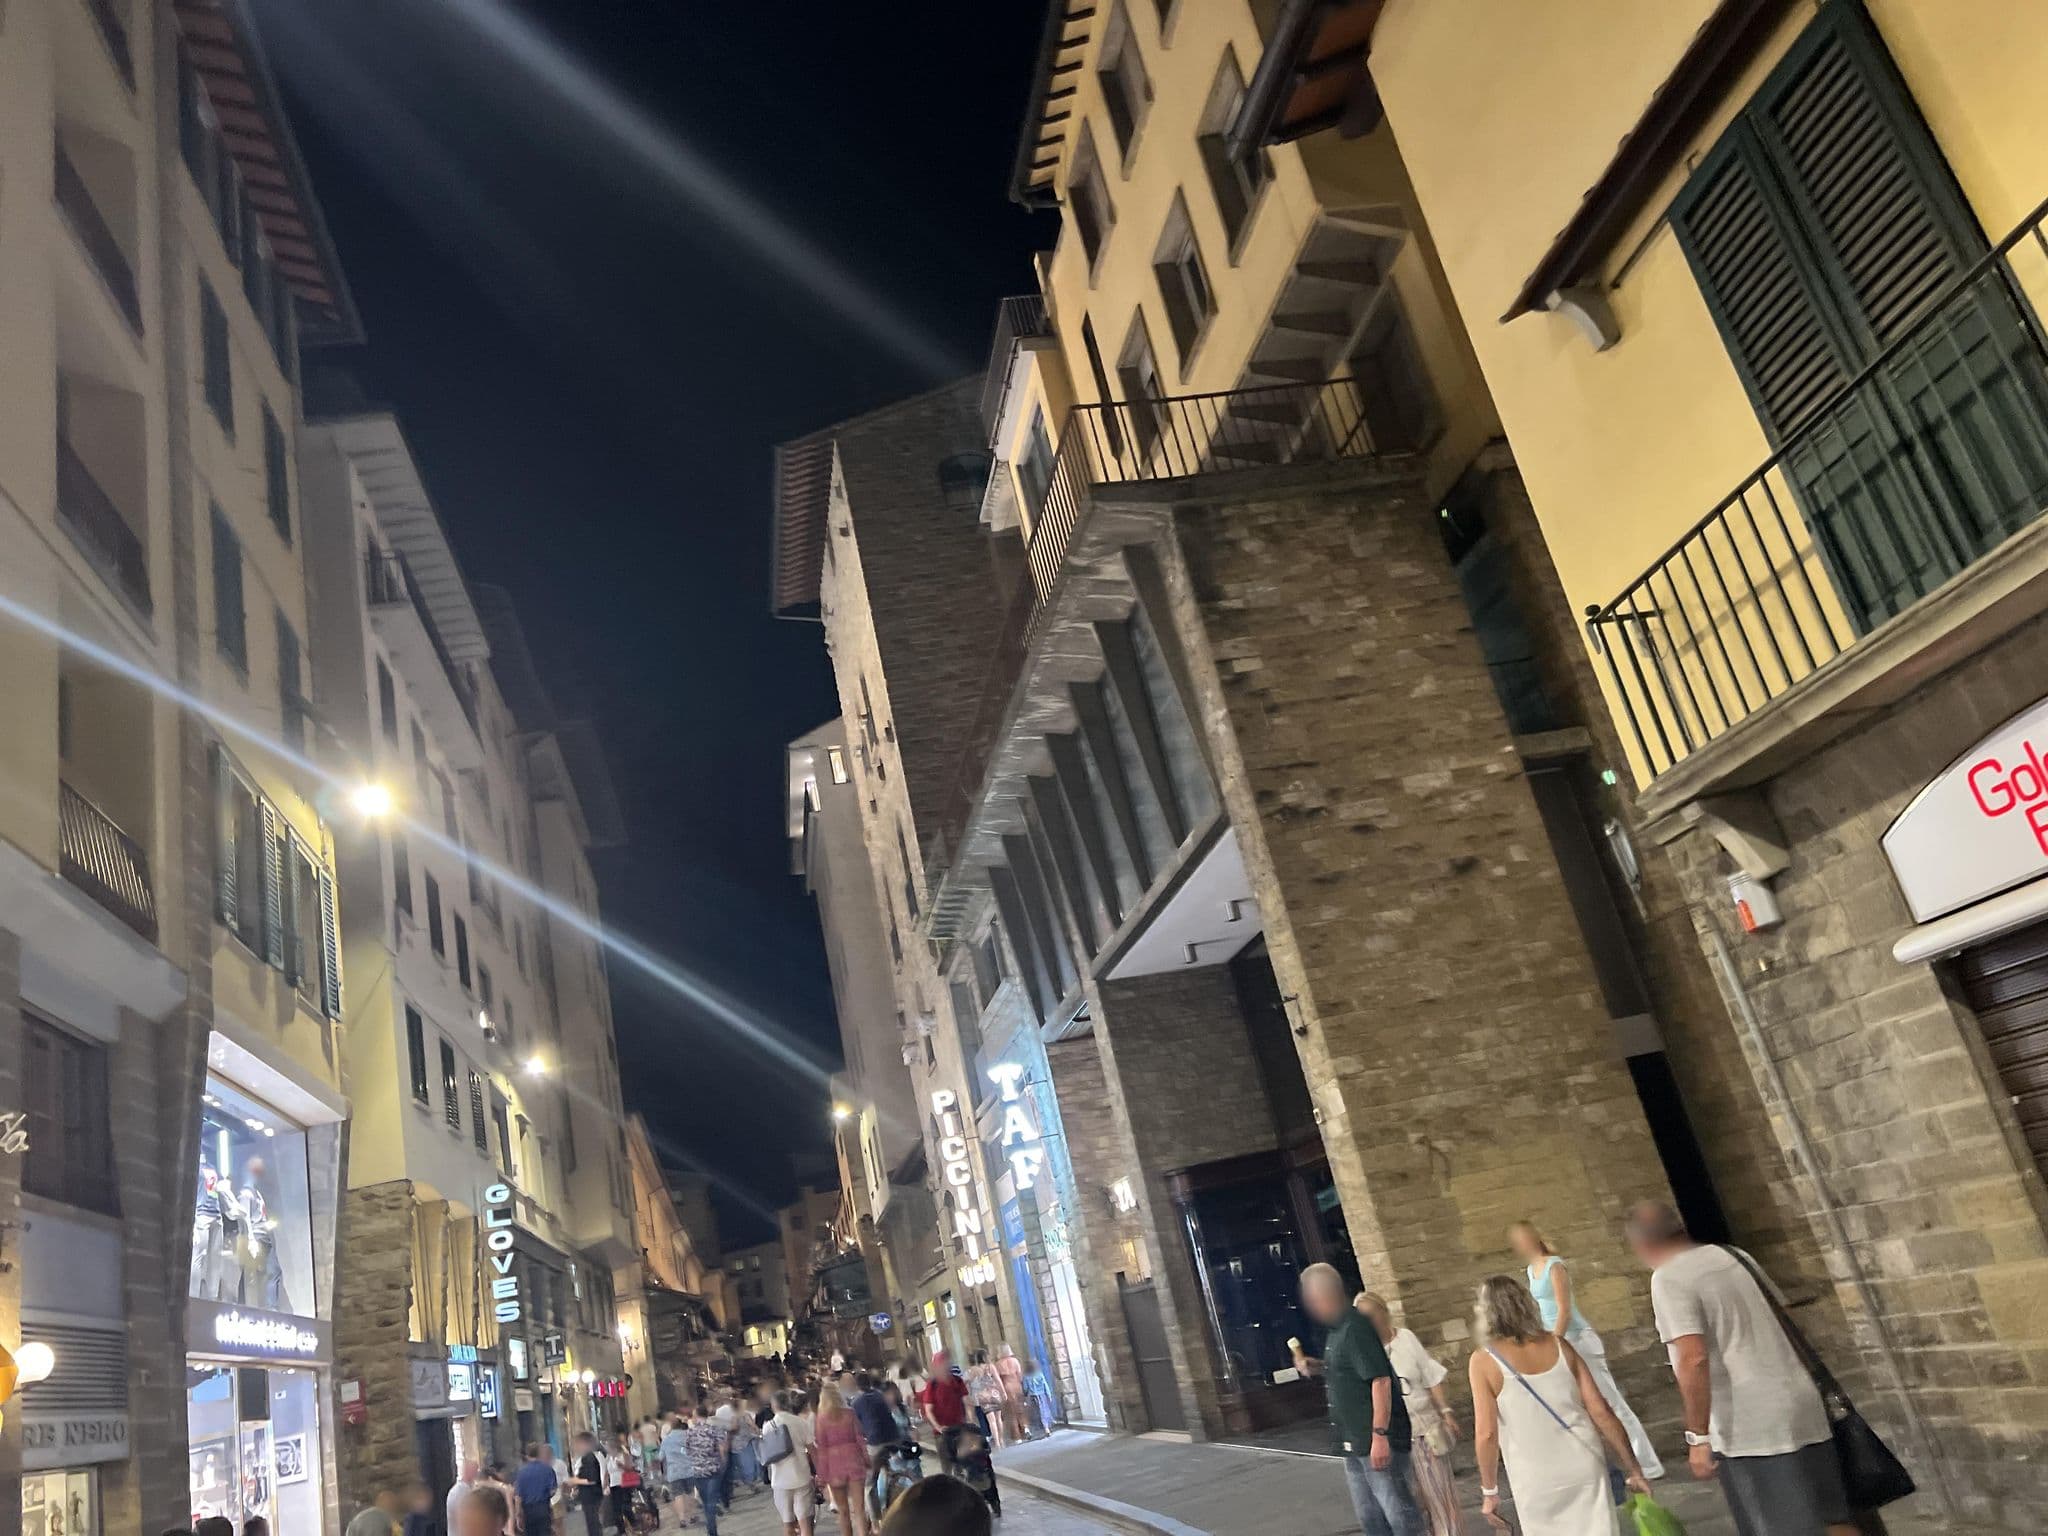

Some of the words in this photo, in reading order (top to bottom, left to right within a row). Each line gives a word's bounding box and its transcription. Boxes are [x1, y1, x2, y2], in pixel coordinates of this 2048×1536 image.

[1967, 741, 2048, 817] Gol
[931, 1089, 981, 1260] PICCINI
[987, 1063, 1044, 1190] TAF
[485, 1183, 521, 1323] GLOVES
